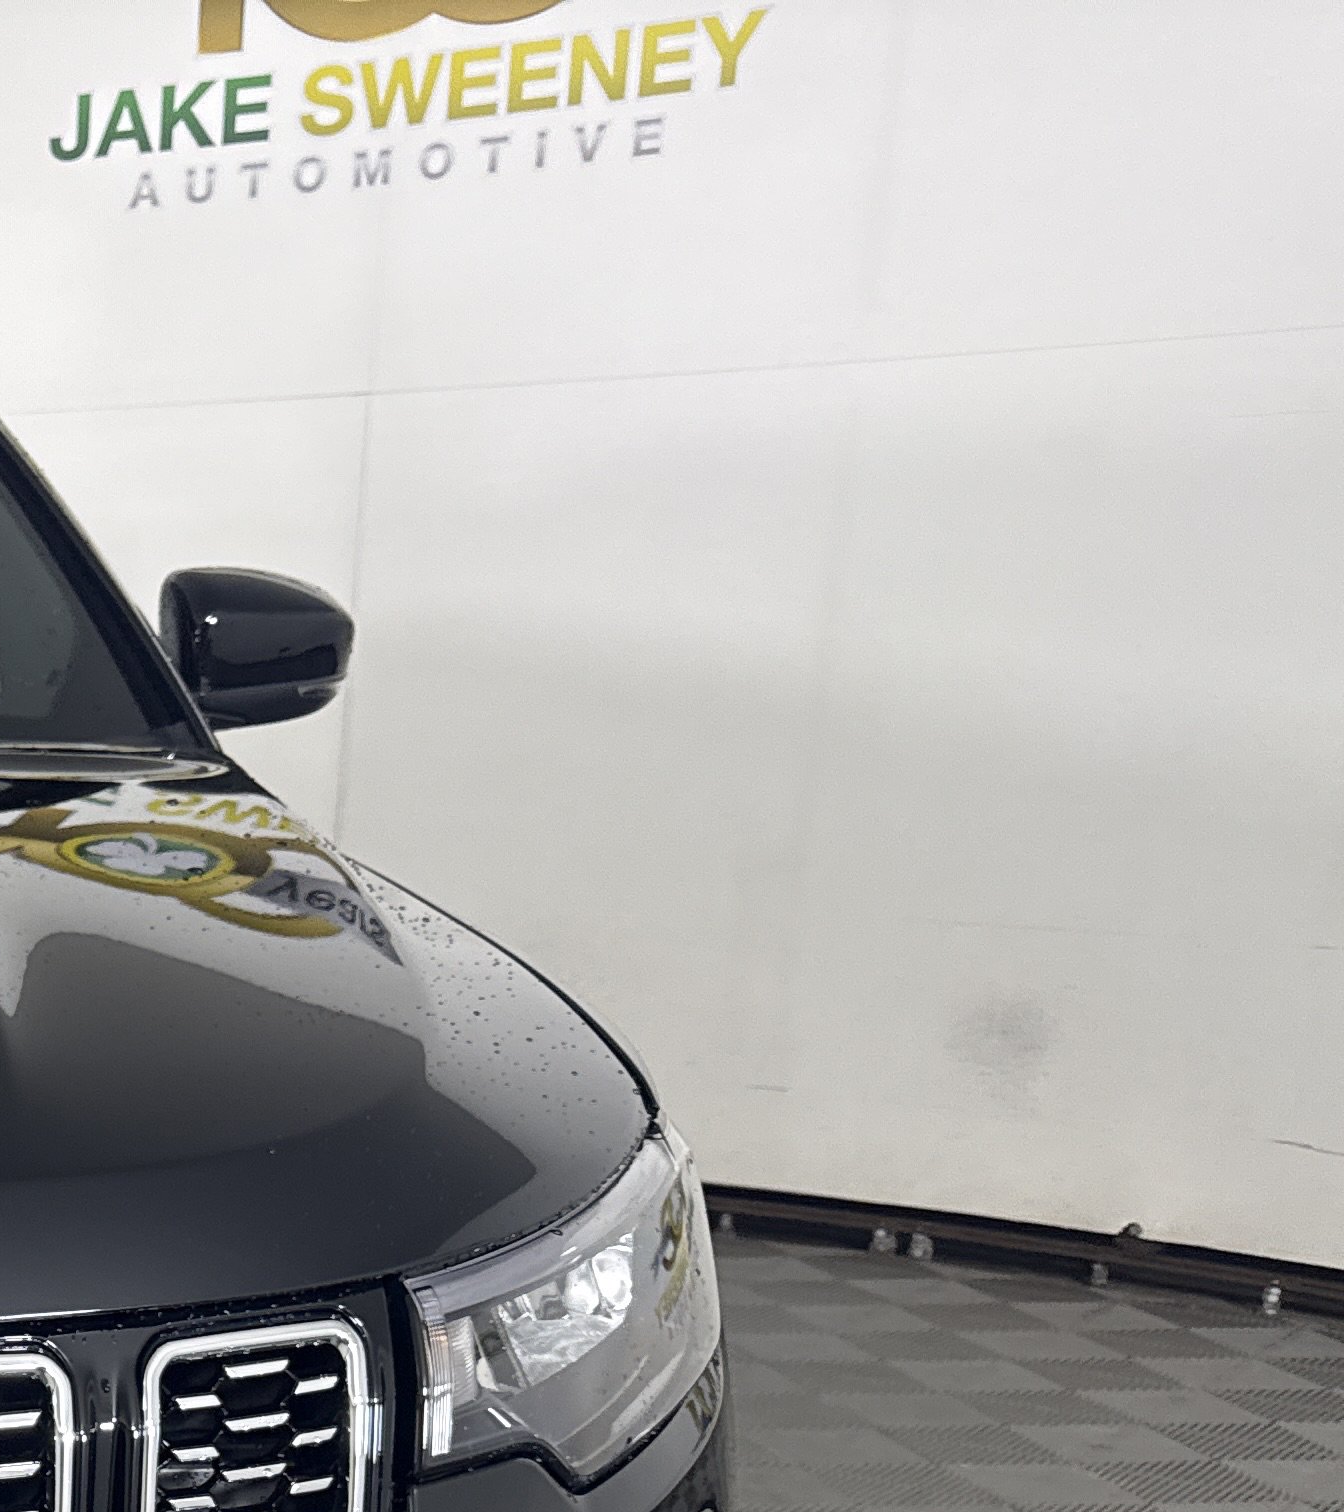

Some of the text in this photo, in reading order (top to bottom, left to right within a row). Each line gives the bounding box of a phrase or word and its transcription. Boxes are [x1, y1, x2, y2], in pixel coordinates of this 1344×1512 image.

[50, 75, 274, 160] JAKE
[300, 10, 767, 137] SWEENEY
[128, 117, 666, 210] AUTOMOTIVE
